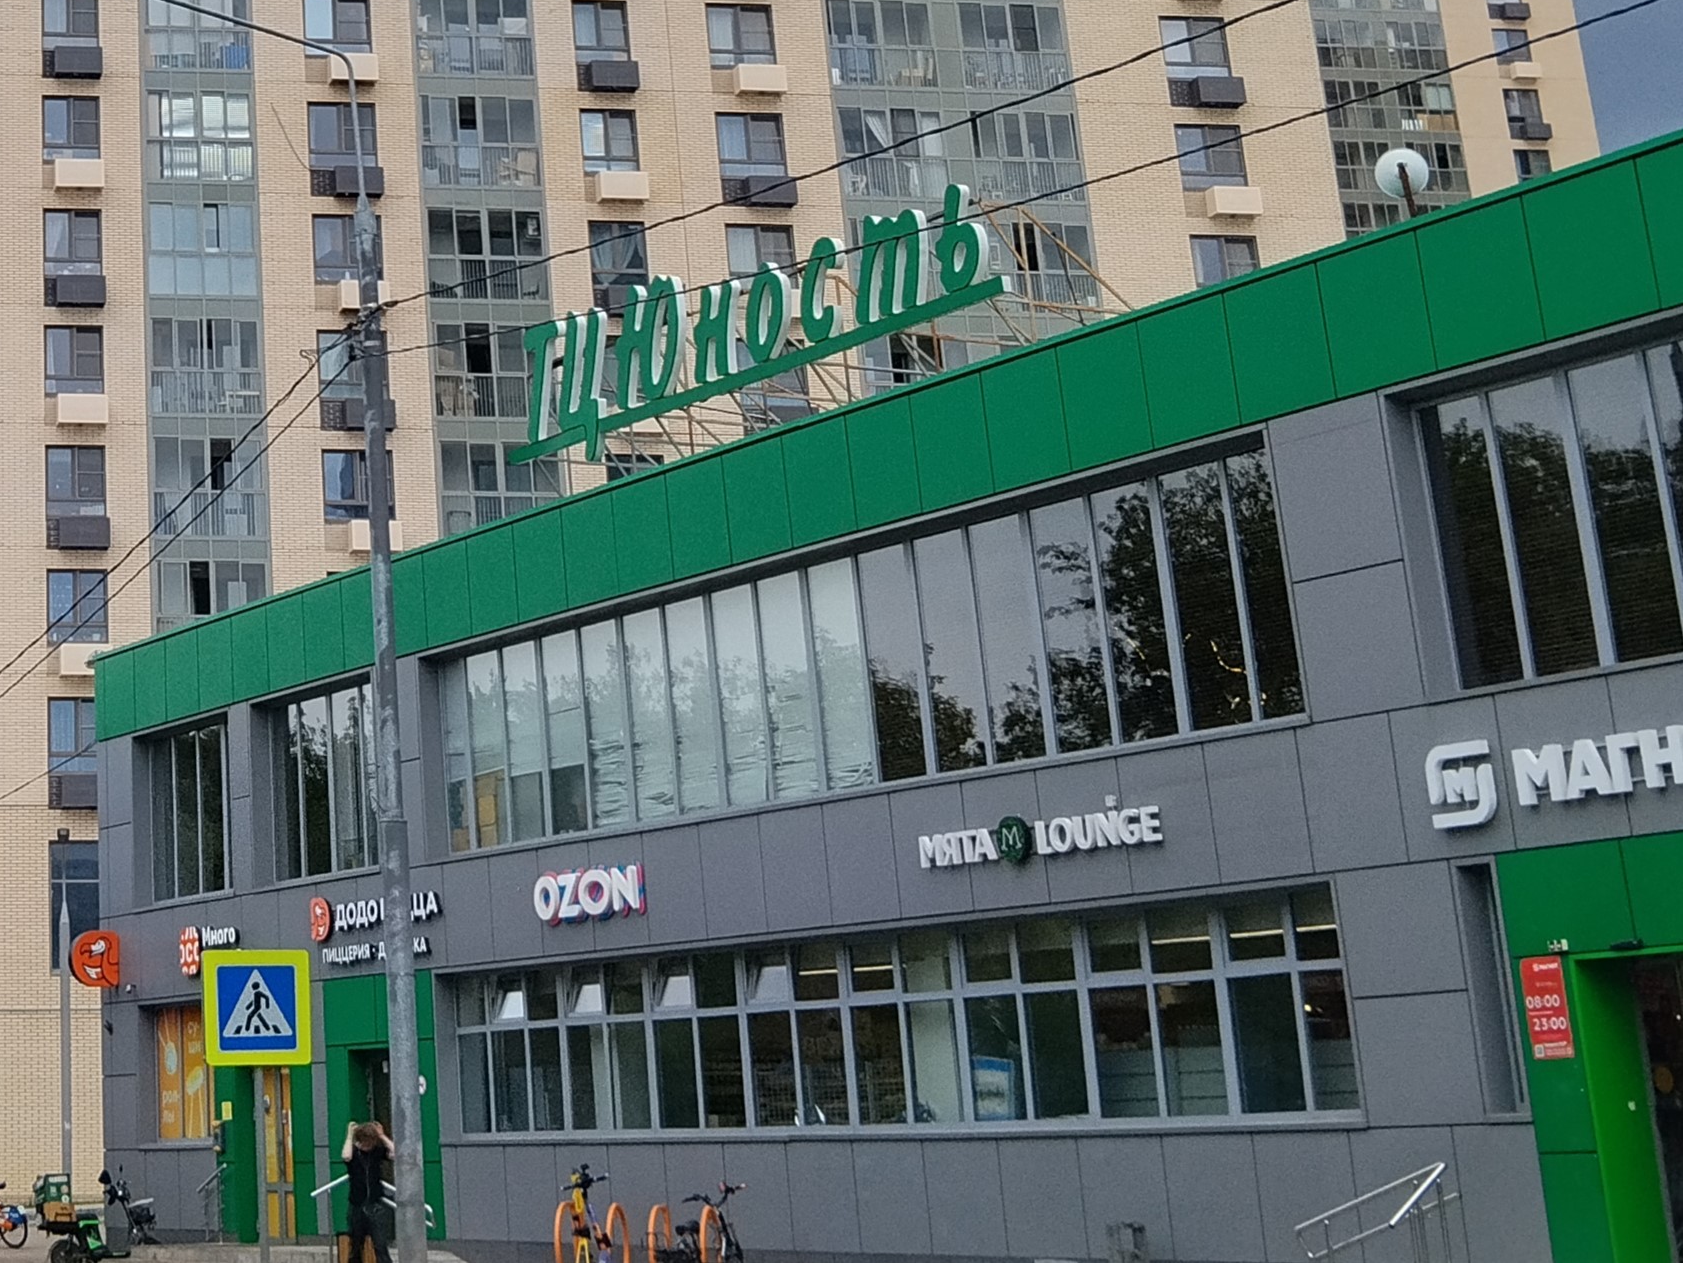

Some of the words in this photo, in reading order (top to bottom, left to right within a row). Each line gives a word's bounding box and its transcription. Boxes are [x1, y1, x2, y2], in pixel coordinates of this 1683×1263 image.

[918, 827, 999, 869] МЯТА
[1034, 804, 1164, 856] LOUNGE
[533, 863, 643, 922] OZON
[335, 898, 379, 932] ДОДО
[201, 925, 236, 948] Много
[322, 942, 372, 965] ПИЦЦЕРИЯ
[1525, 994, 1560, 1009] 08:00
[1533, 1017, 1566, 1031] 23:00
